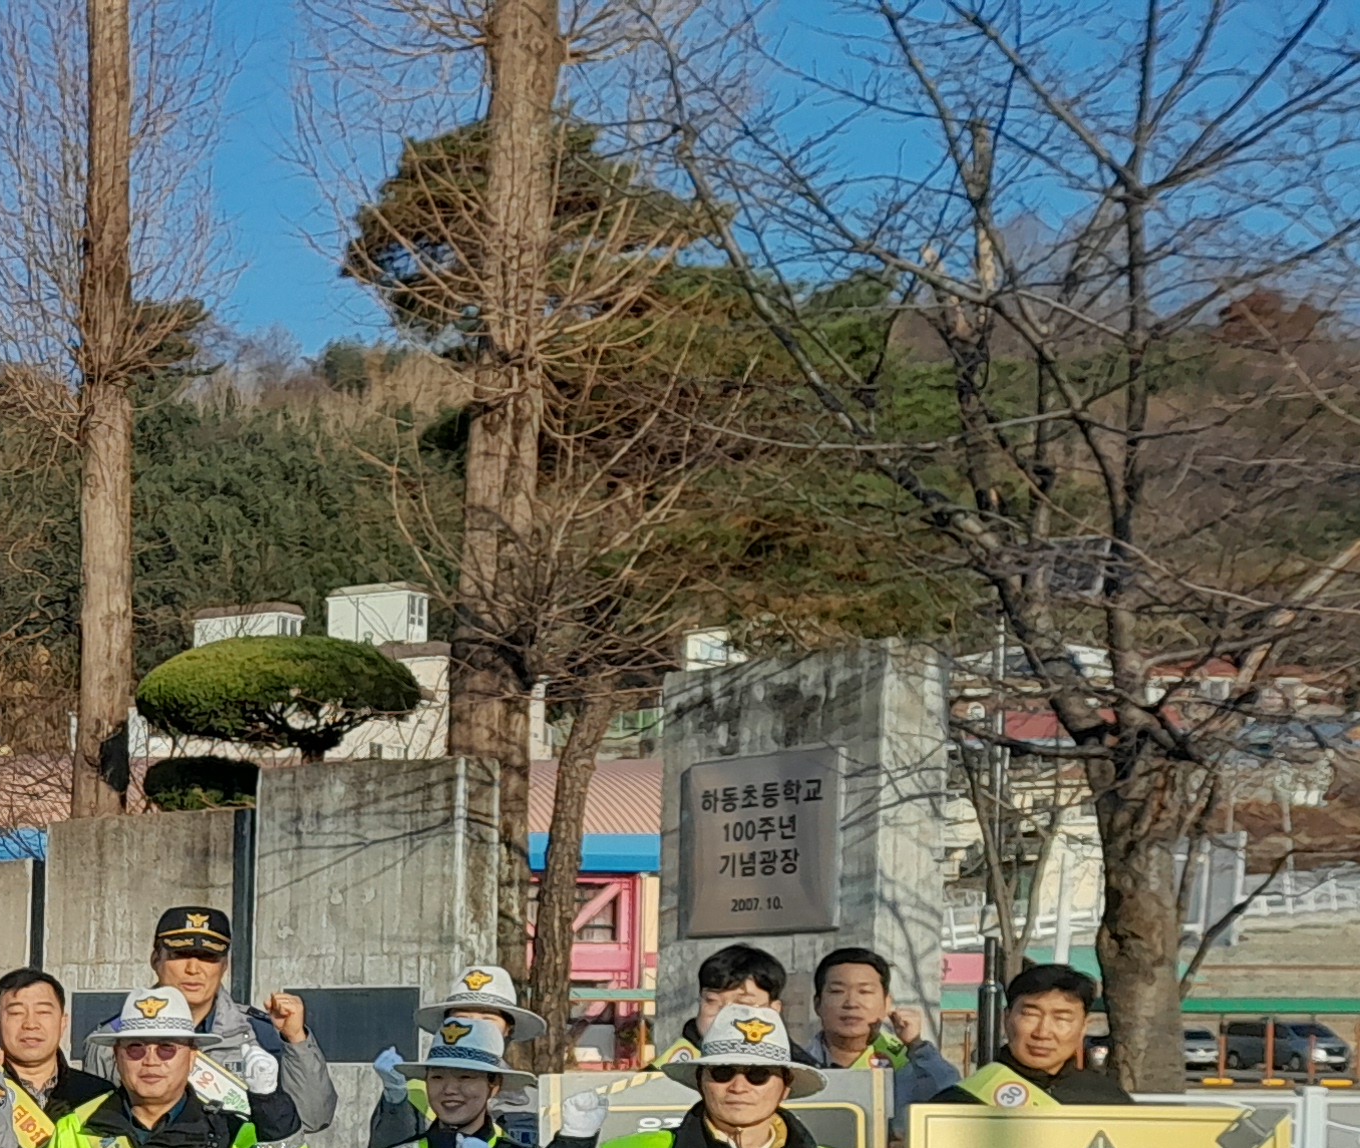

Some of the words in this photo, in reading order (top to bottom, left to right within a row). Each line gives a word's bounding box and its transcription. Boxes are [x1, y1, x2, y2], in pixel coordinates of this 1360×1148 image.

[701, 779, 823, 813] 하동초등학교
[723, 814, 796, 842] 100주년
[719, 847, 800, 878] 기념광장
[731, 897, 762, 912] 2007.
[999, 1086, 1023, 1106] 30
